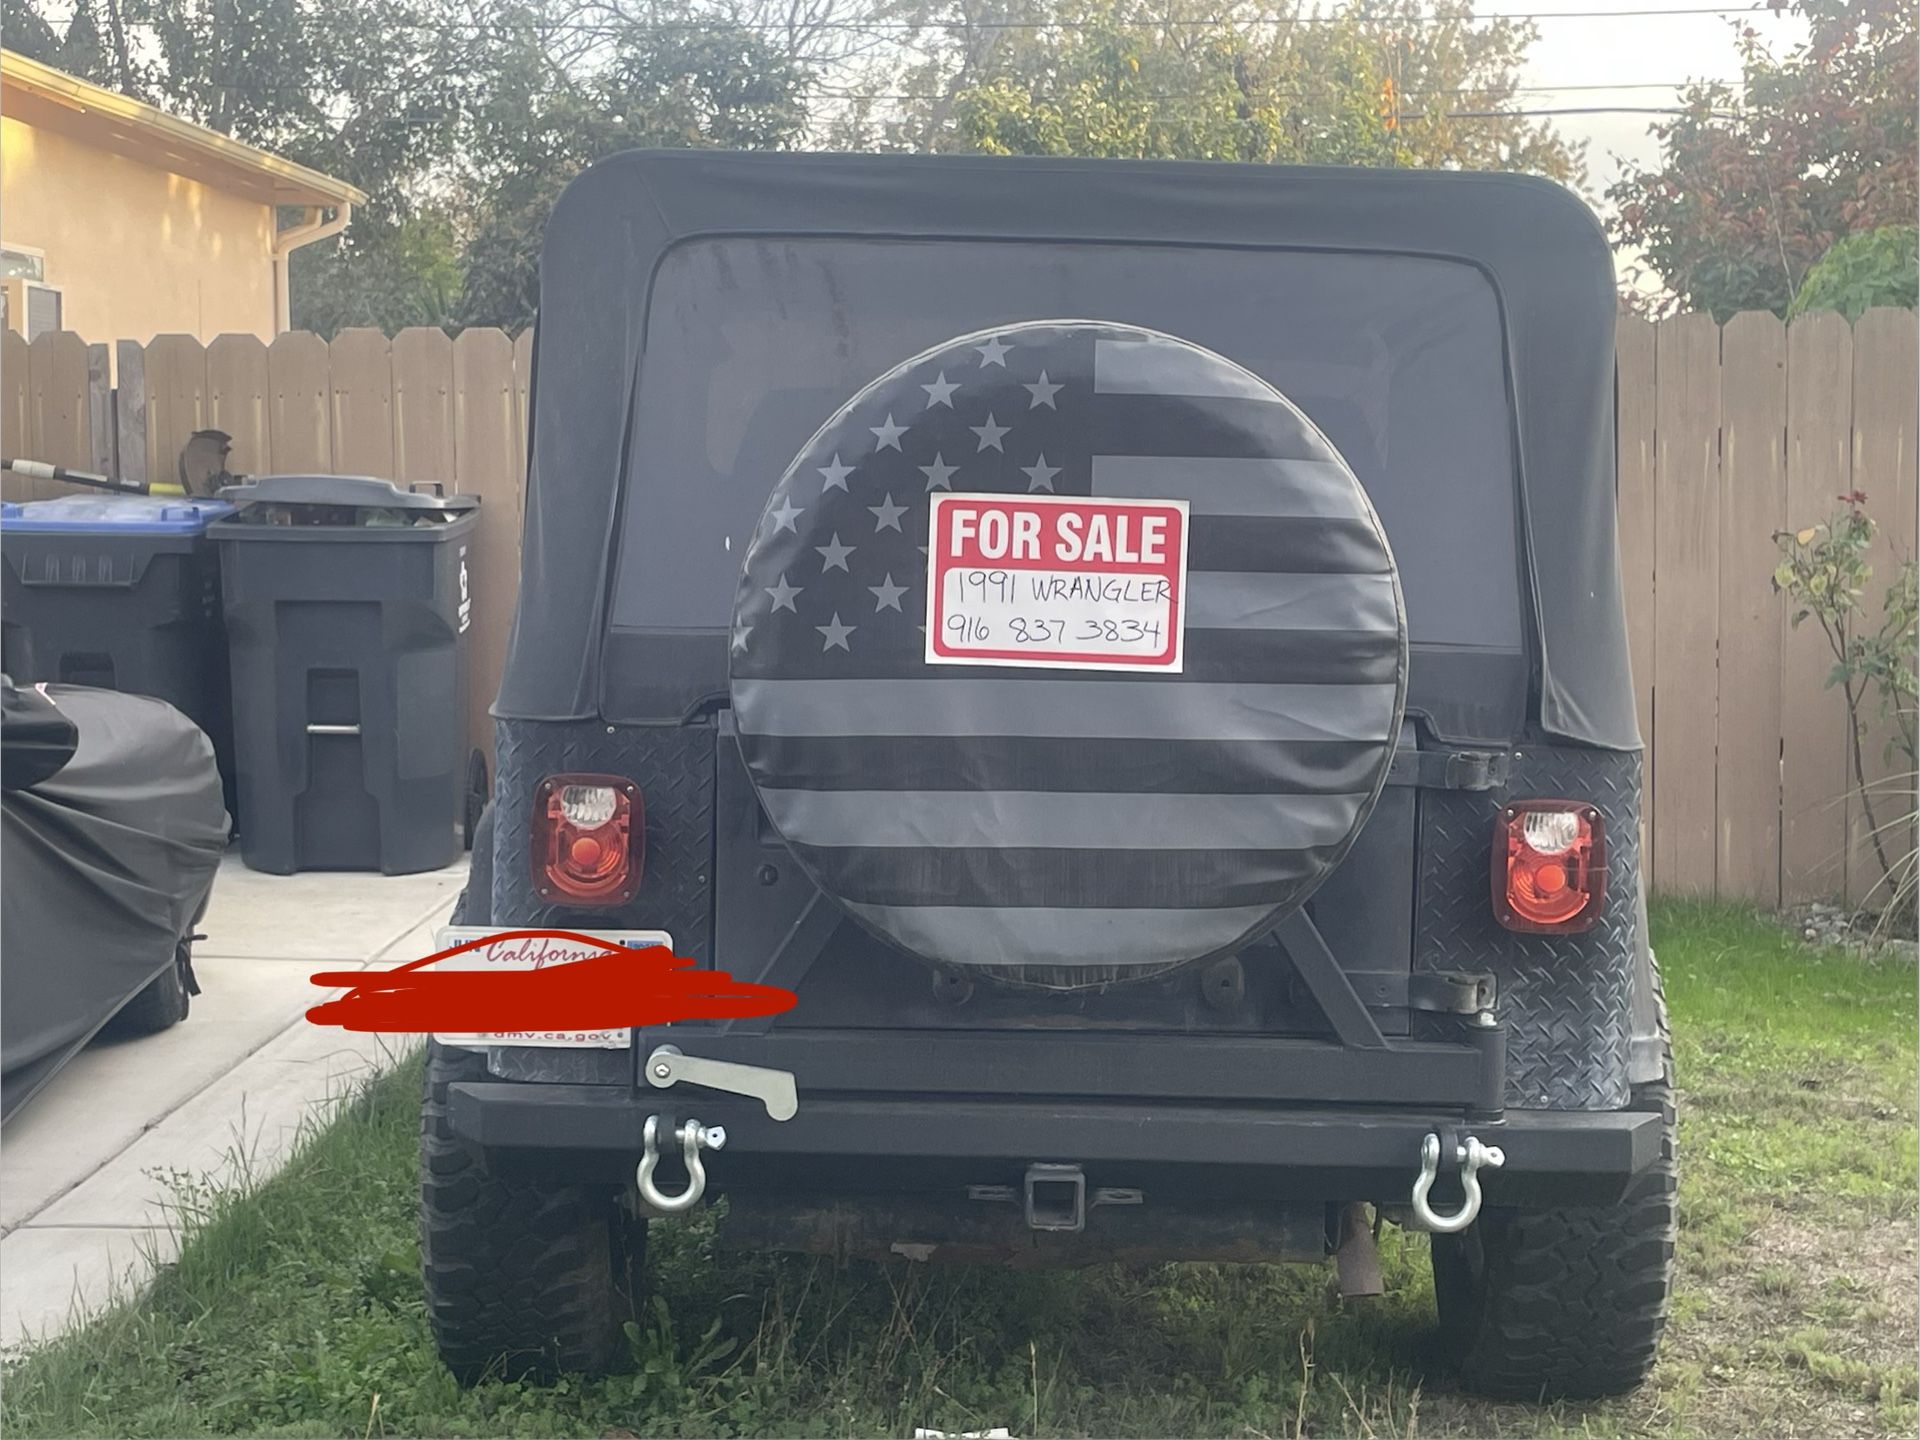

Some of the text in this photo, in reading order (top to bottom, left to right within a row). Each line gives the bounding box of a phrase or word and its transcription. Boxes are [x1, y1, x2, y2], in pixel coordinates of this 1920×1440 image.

[950, 508, 1168, 564] FOR SALE
[958, 570, 1179, 604] 1991 WRANGLER
[946, 614, 1161, 648] 916 837 3834
